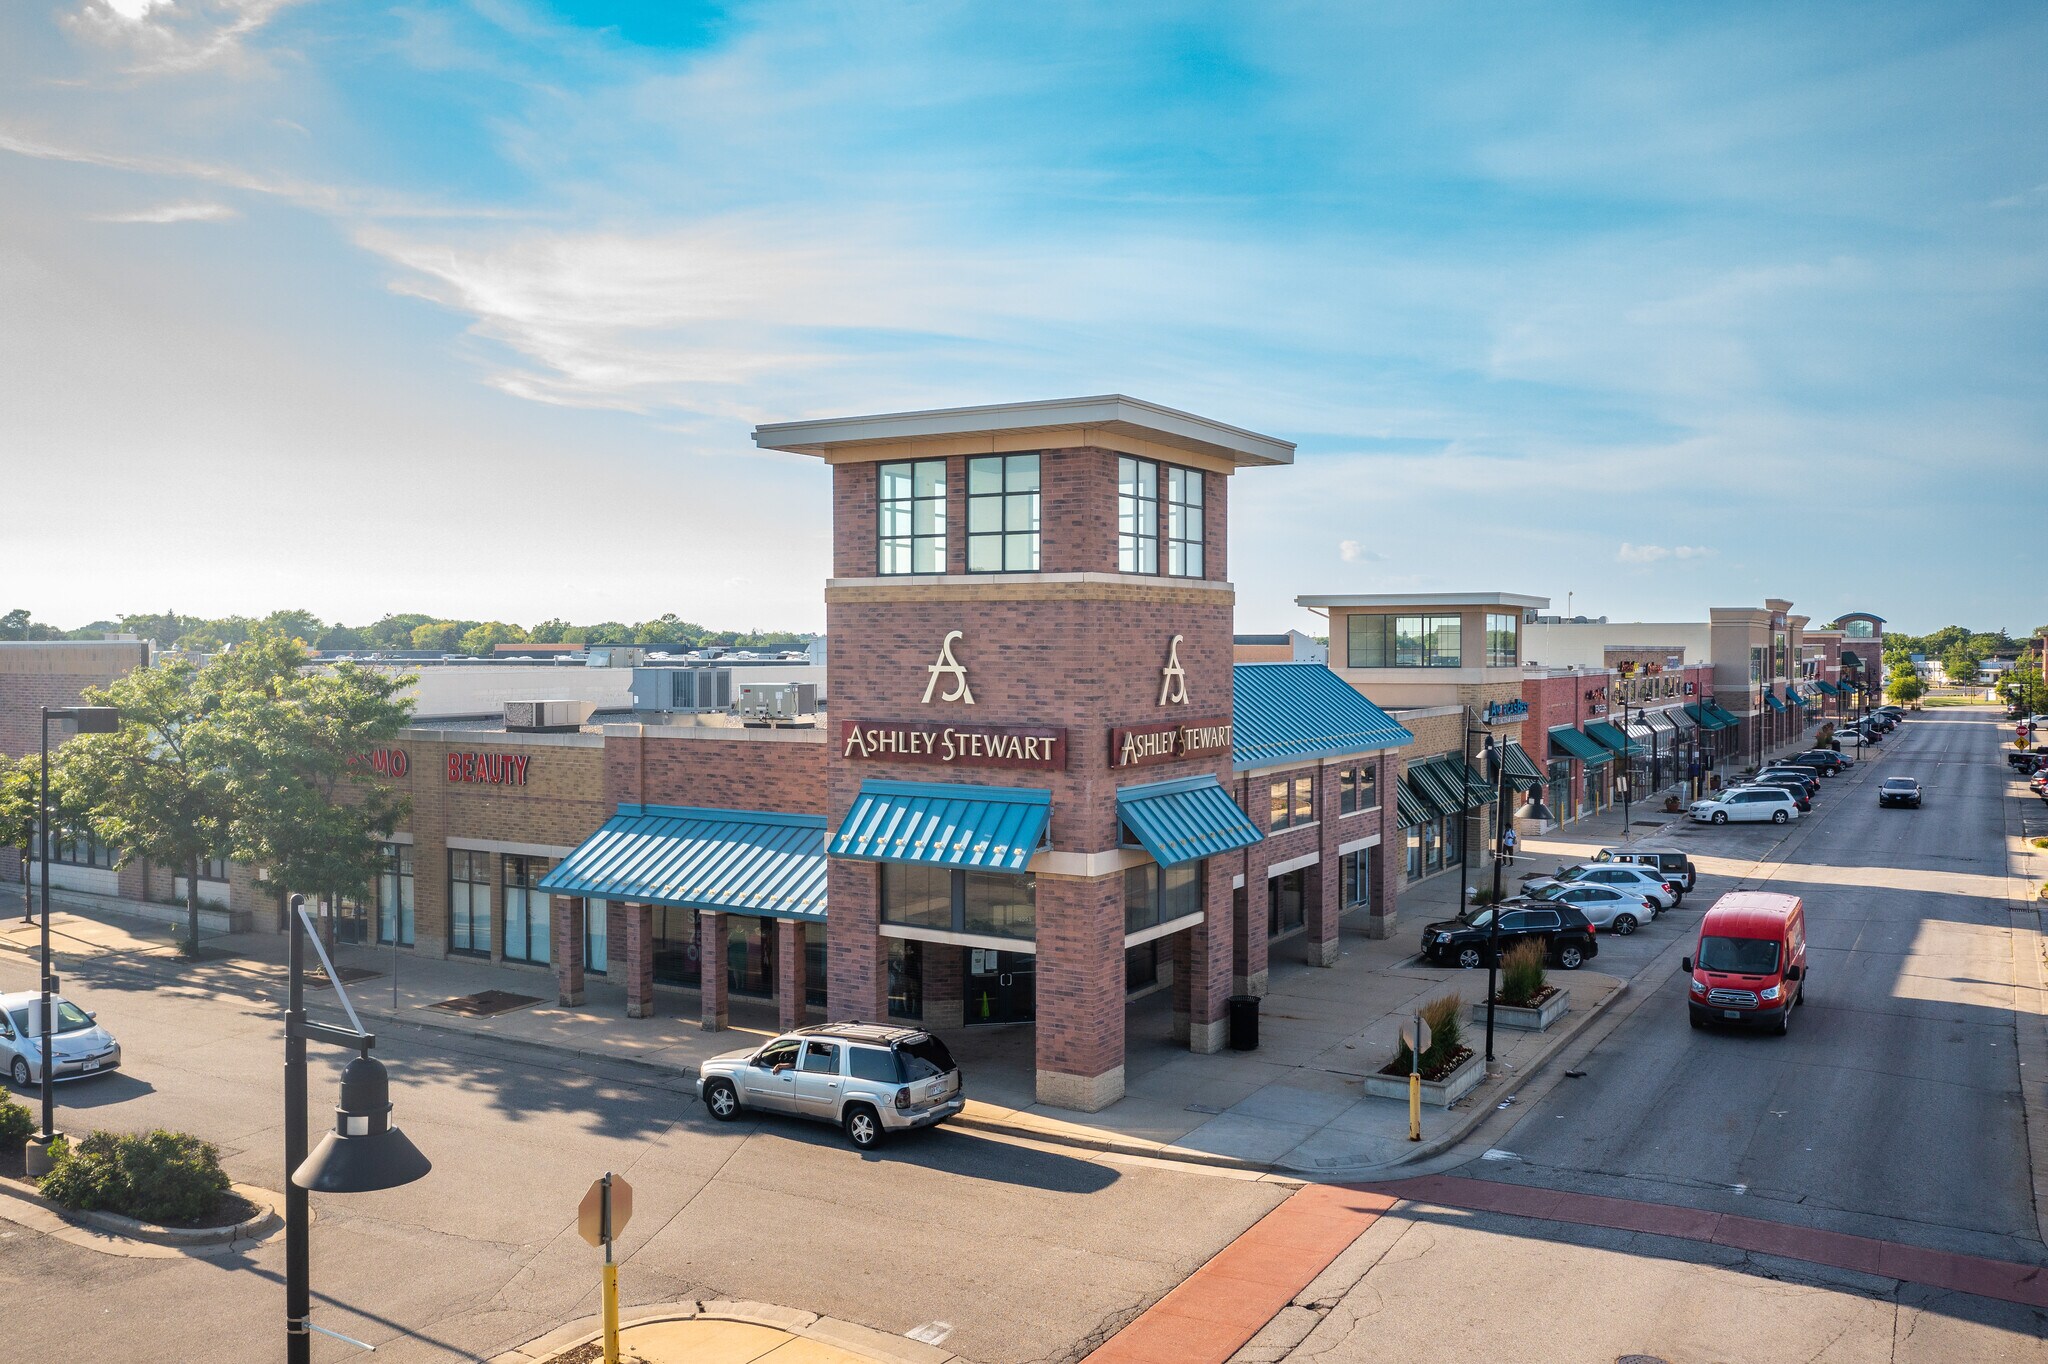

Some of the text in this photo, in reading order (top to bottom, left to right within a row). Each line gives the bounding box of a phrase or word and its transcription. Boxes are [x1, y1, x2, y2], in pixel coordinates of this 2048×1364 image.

[844, 724, 1057, 761] ASHLEY STEWART
[1120, 725, 1232, 766] ASHLEY STEWART
[448, 752, 529, 786] BEAUTY
